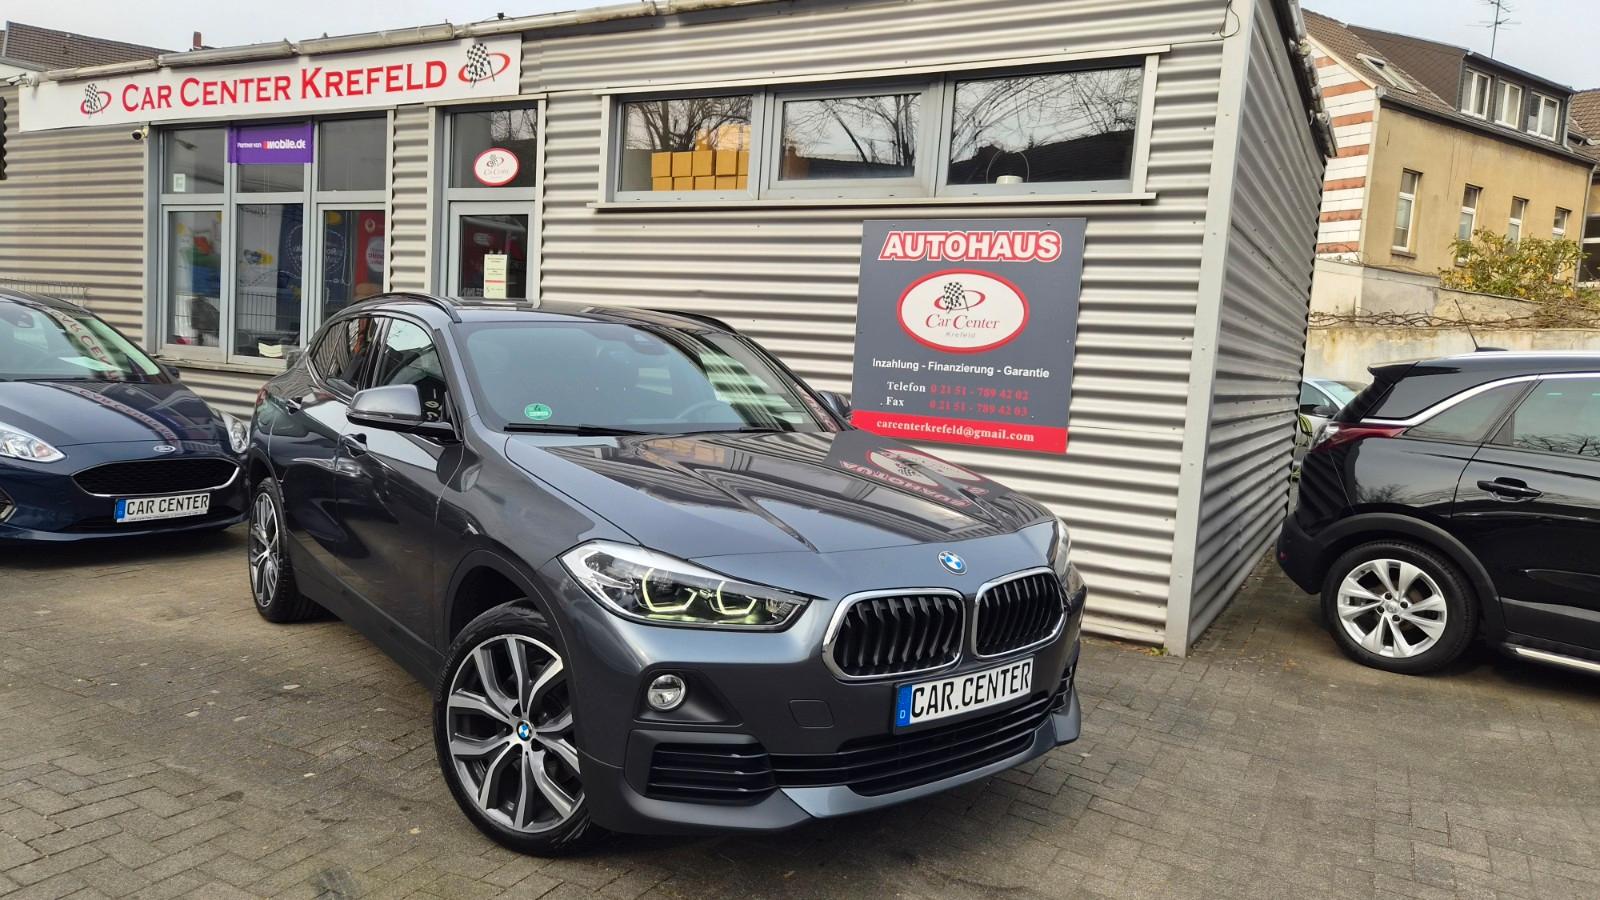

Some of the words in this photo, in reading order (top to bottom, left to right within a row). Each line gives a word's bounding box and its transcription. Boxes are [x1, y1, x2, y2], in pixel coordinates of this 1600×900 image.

[122, 83, 172, 112] CAR
[180, 75, 292, 107] CENTER
[301, 60, 448, 98] KREFELD
[878, 230, 1062, 262] AUTOHAUS
[925, 313, 951, 329] Car
[952, 314, 1001, 330] Center
[872, 358, 920, 371] Inzahlung
[928, 361, 994, 377] Finanzierung
[1003, 366, 1050, 379] Garantie
[887, 381, 926, 393] Telefon
[886, 396, 904, 407] Fax
[876, 419, 1035, 443] carcenterkrefeld@gmail.com
[127, 500, 155, 515] CAR
[158, 494, 209, 513] CENTER
[911, 662, 1031, 718] CAR.CENTER
